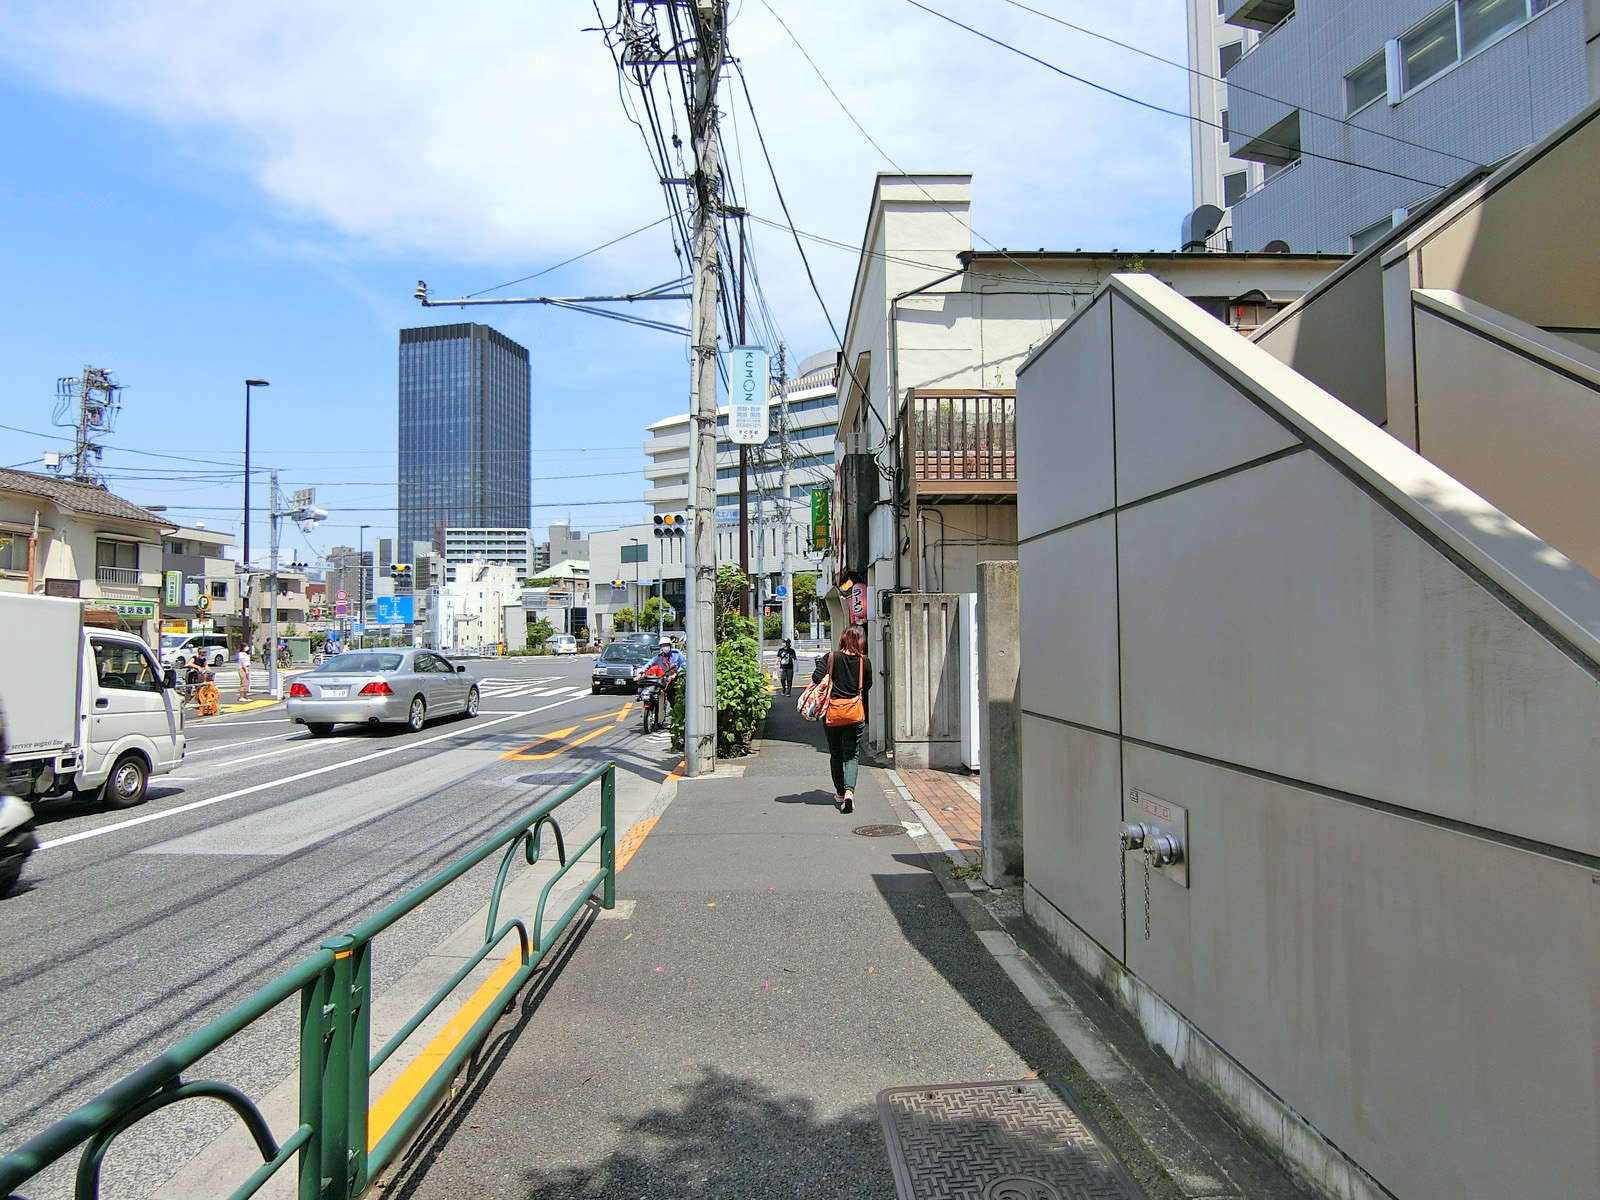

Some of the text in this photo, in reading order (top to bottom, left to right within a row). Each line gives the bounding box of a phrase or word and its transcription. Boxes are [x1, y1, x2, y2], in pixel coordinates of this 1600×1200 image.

[743, 352, 755, 401] KUMON
[815, 492, 827, 548] ツイン薬局
[201, 597, 208, 608] P
[853, 588, 863, 613] ラーメン
